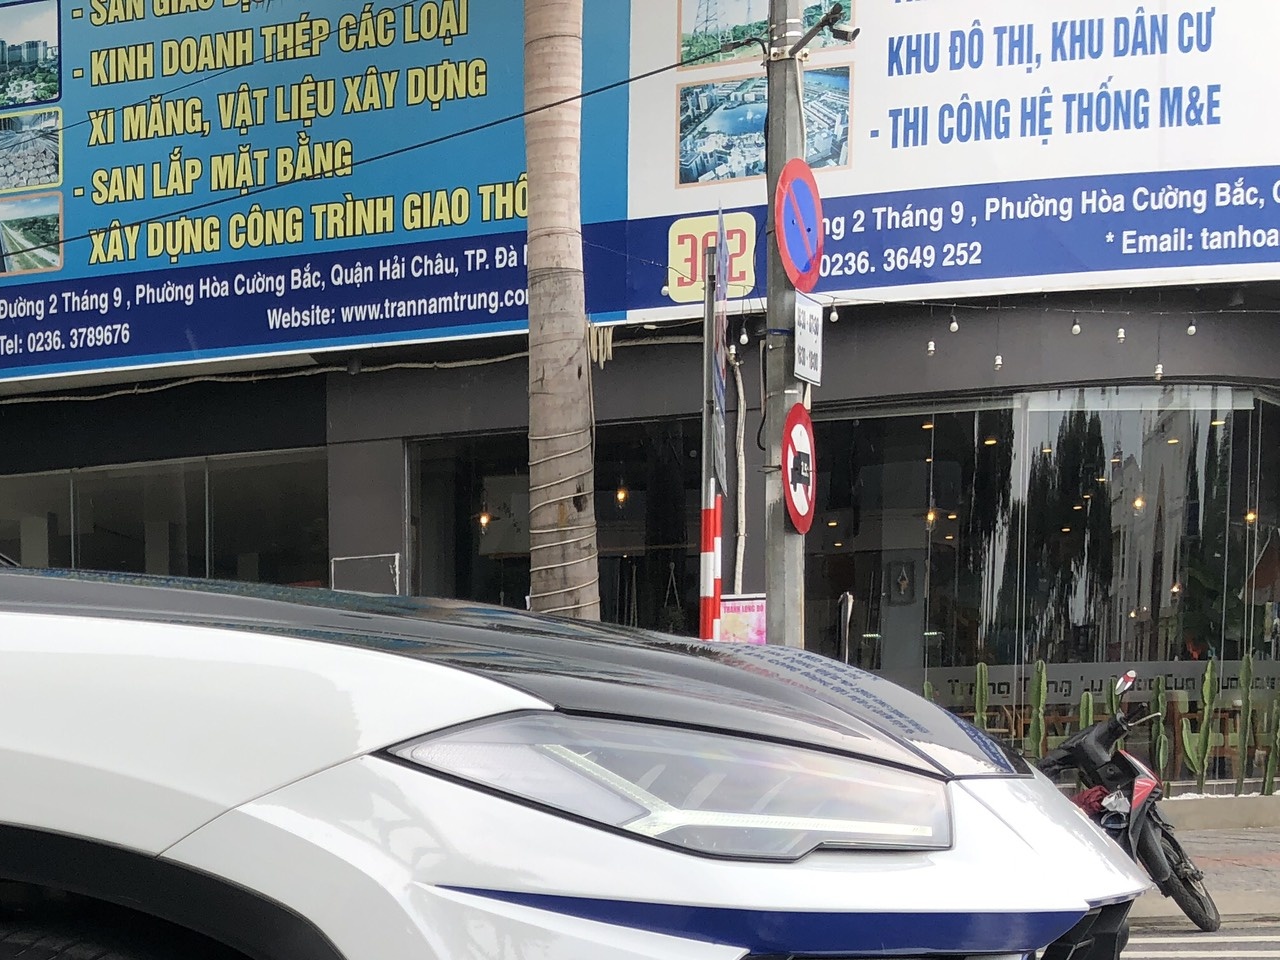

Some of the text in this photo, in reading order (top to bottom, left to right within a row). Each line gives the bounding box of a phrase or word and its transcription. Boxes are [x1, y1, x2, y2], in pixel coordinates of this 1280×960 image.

[90, 42, 155, 87] KINH
[161, 28, 254, 77] DOANH
[260, 12, 330, 63] THÉP
[338, 2, 396, 52] CÁC
[403, 0, 469, 45] LOẠI
[887, 6, 1216, 77] KHU ĐÔ THỊ, KHU DÂN CƯ
[87, 57, 488, 147] XI MĂNG, VẬT LIỆU XÂY DỰNG
[888, 106, 929, 149] THI
[937, 93, 1011, 145] CÔNG
[1019, 86, 1053, 146] HỆ
[1062, 75, 1150, 134] THỐNG
[1159, 84, 1222, 129] M&E
[91, 164, 144, 205] SAN
[152, 146, 202, 198] LẮP
[210, 144, 269, 195] MẶT
[275, 131, 353, 184] BẰNG
[88, 171, 528, 265] XÂY DỰNG CÔNG TRÌNH GIAO THÔ
[852, 209, 866, 233] 2
[871, 205, 944, 234] Tháng
[985, 192, 1073, 222] Phường
[1080, 188, 1125, 214] Hòa
[1132, 185, 1208, 214] Cường
[1215, 177, 1265, 209] Bắc,
[1121, 225, 1279, 254] Email: tanhoa
[48, 294, 58, 315] 2
[61, 289, 109, 315] Tháng
[135, 281, 194, 306] Phường
[199, 277, 230, 299] Hòa
[233, 272, 285, 297] Cường
[290, 262, 326, 292] Bắc,
[330, 261, 373, 288] Quận
[379, 255, 406, 281] Hải
[410, 254, 459, 278] Châu,
[464, 248, 490, 272] TP.
[495, 245, 518, 269] Đà
[819, 241, 982, 278] 0236. 3649 252
[27, 330, 66, 353] 0236.
[69, 323, 130, 349] 3789676
[267, 304, 335, 330] Website:
